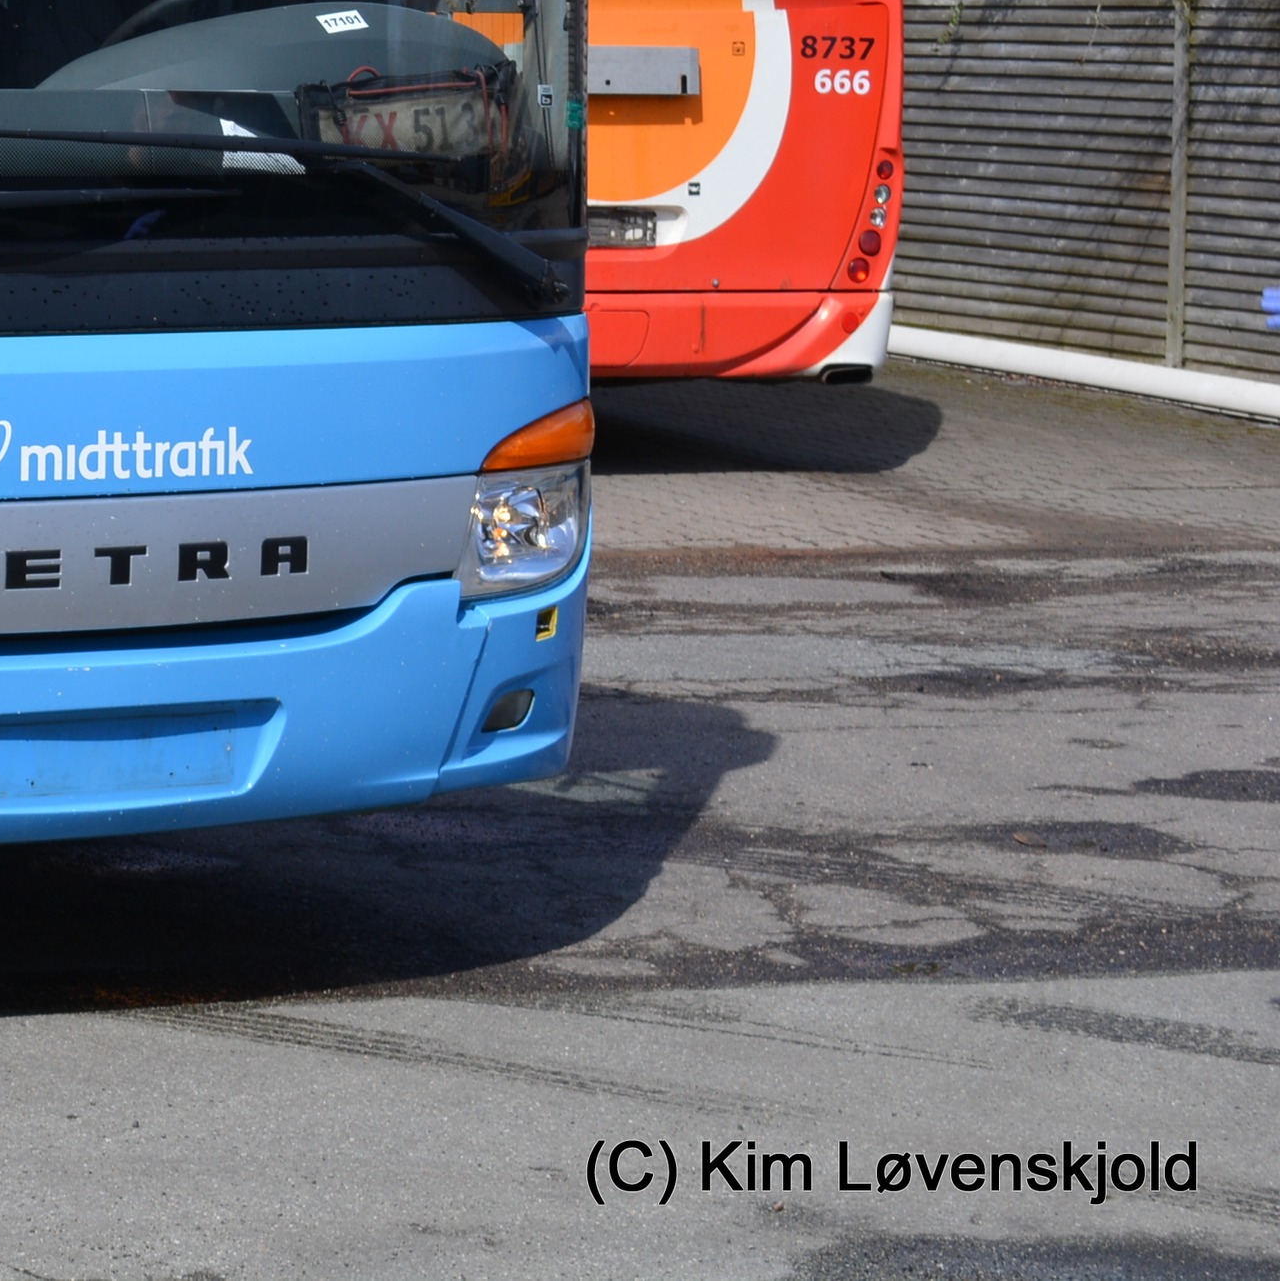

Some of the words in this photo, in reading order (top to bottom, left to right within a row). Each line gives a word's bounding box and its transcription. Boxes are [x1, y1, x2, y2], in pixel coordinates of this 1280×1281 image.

[323, 14, 362, 28] 17101
[800, 35, 875, 60] 8737
[814, 68, 870, 95] 666
[20, 426, 254, 482] midttrafik
